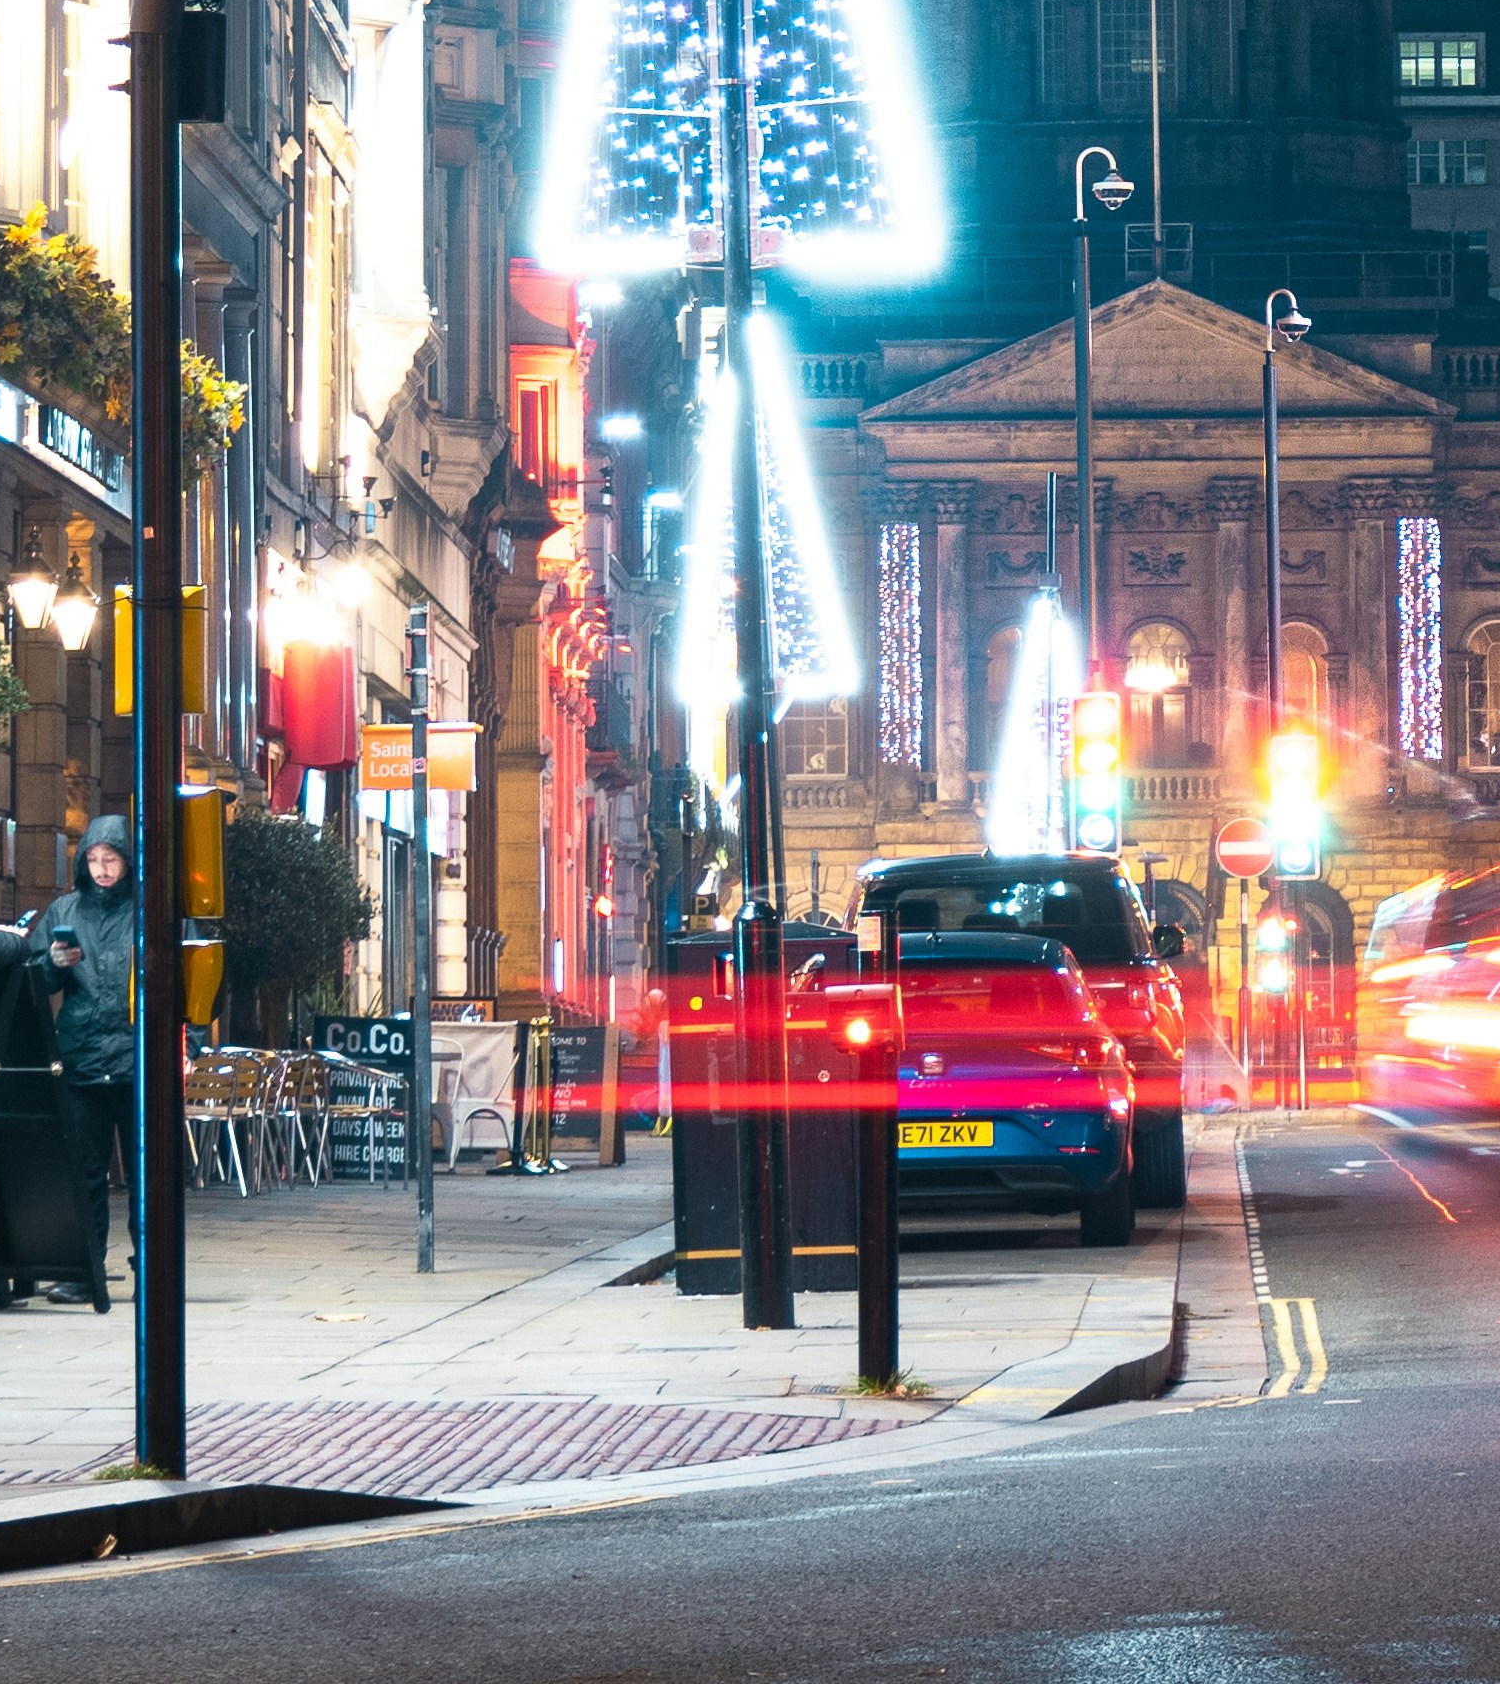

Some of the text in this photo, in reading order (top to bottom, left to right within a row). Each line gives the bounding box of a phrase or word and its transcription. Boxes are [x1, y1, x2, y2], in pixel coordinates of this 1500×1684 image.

[370, 761, 414, 777] Local
[332, 1120, 362, 1137] DAYS
[900, 1125, 978, 1143] E71 ZKV
[334, 1144, 360, 1161] HIRE
